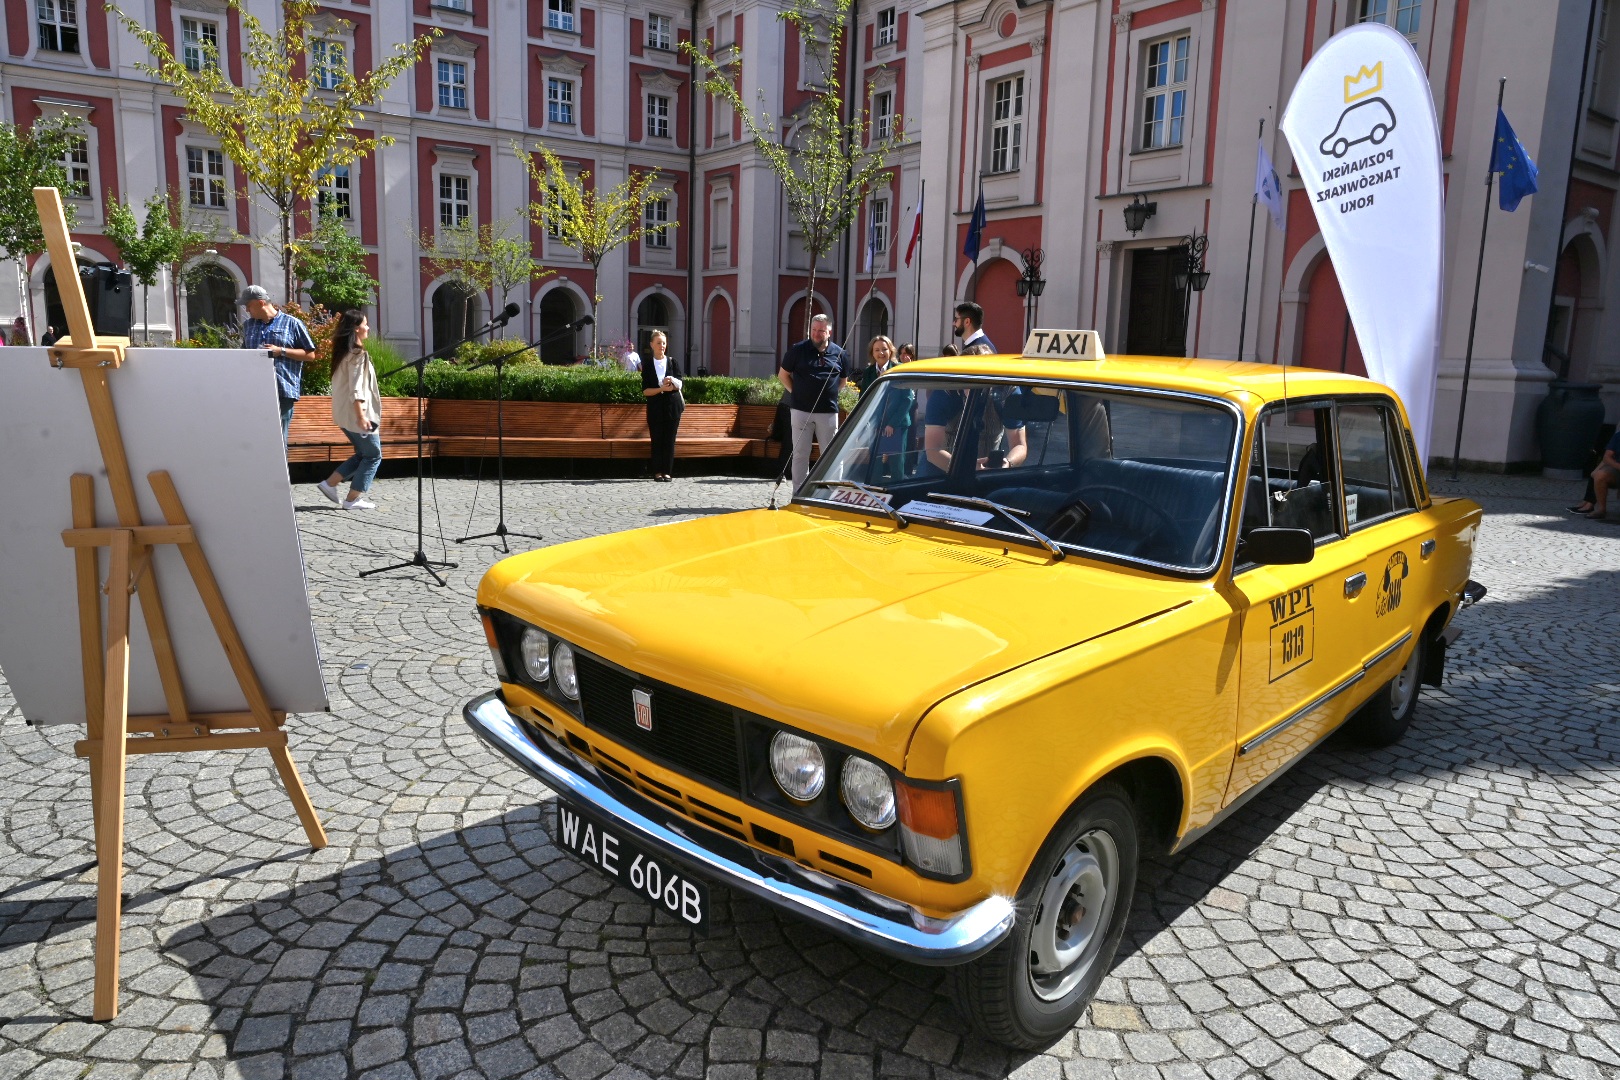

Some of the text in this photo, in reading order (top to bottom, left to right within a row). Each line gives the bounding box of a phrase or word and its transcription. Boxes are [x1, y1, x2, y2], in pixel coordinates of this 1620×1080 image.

[1034, 332, 1088, 355] TAXI
[1268, 583, 1315, 623] WPT
[1281, 624, 1304, 665] 1313
[560, 807, 702, 924] WAE 606B
